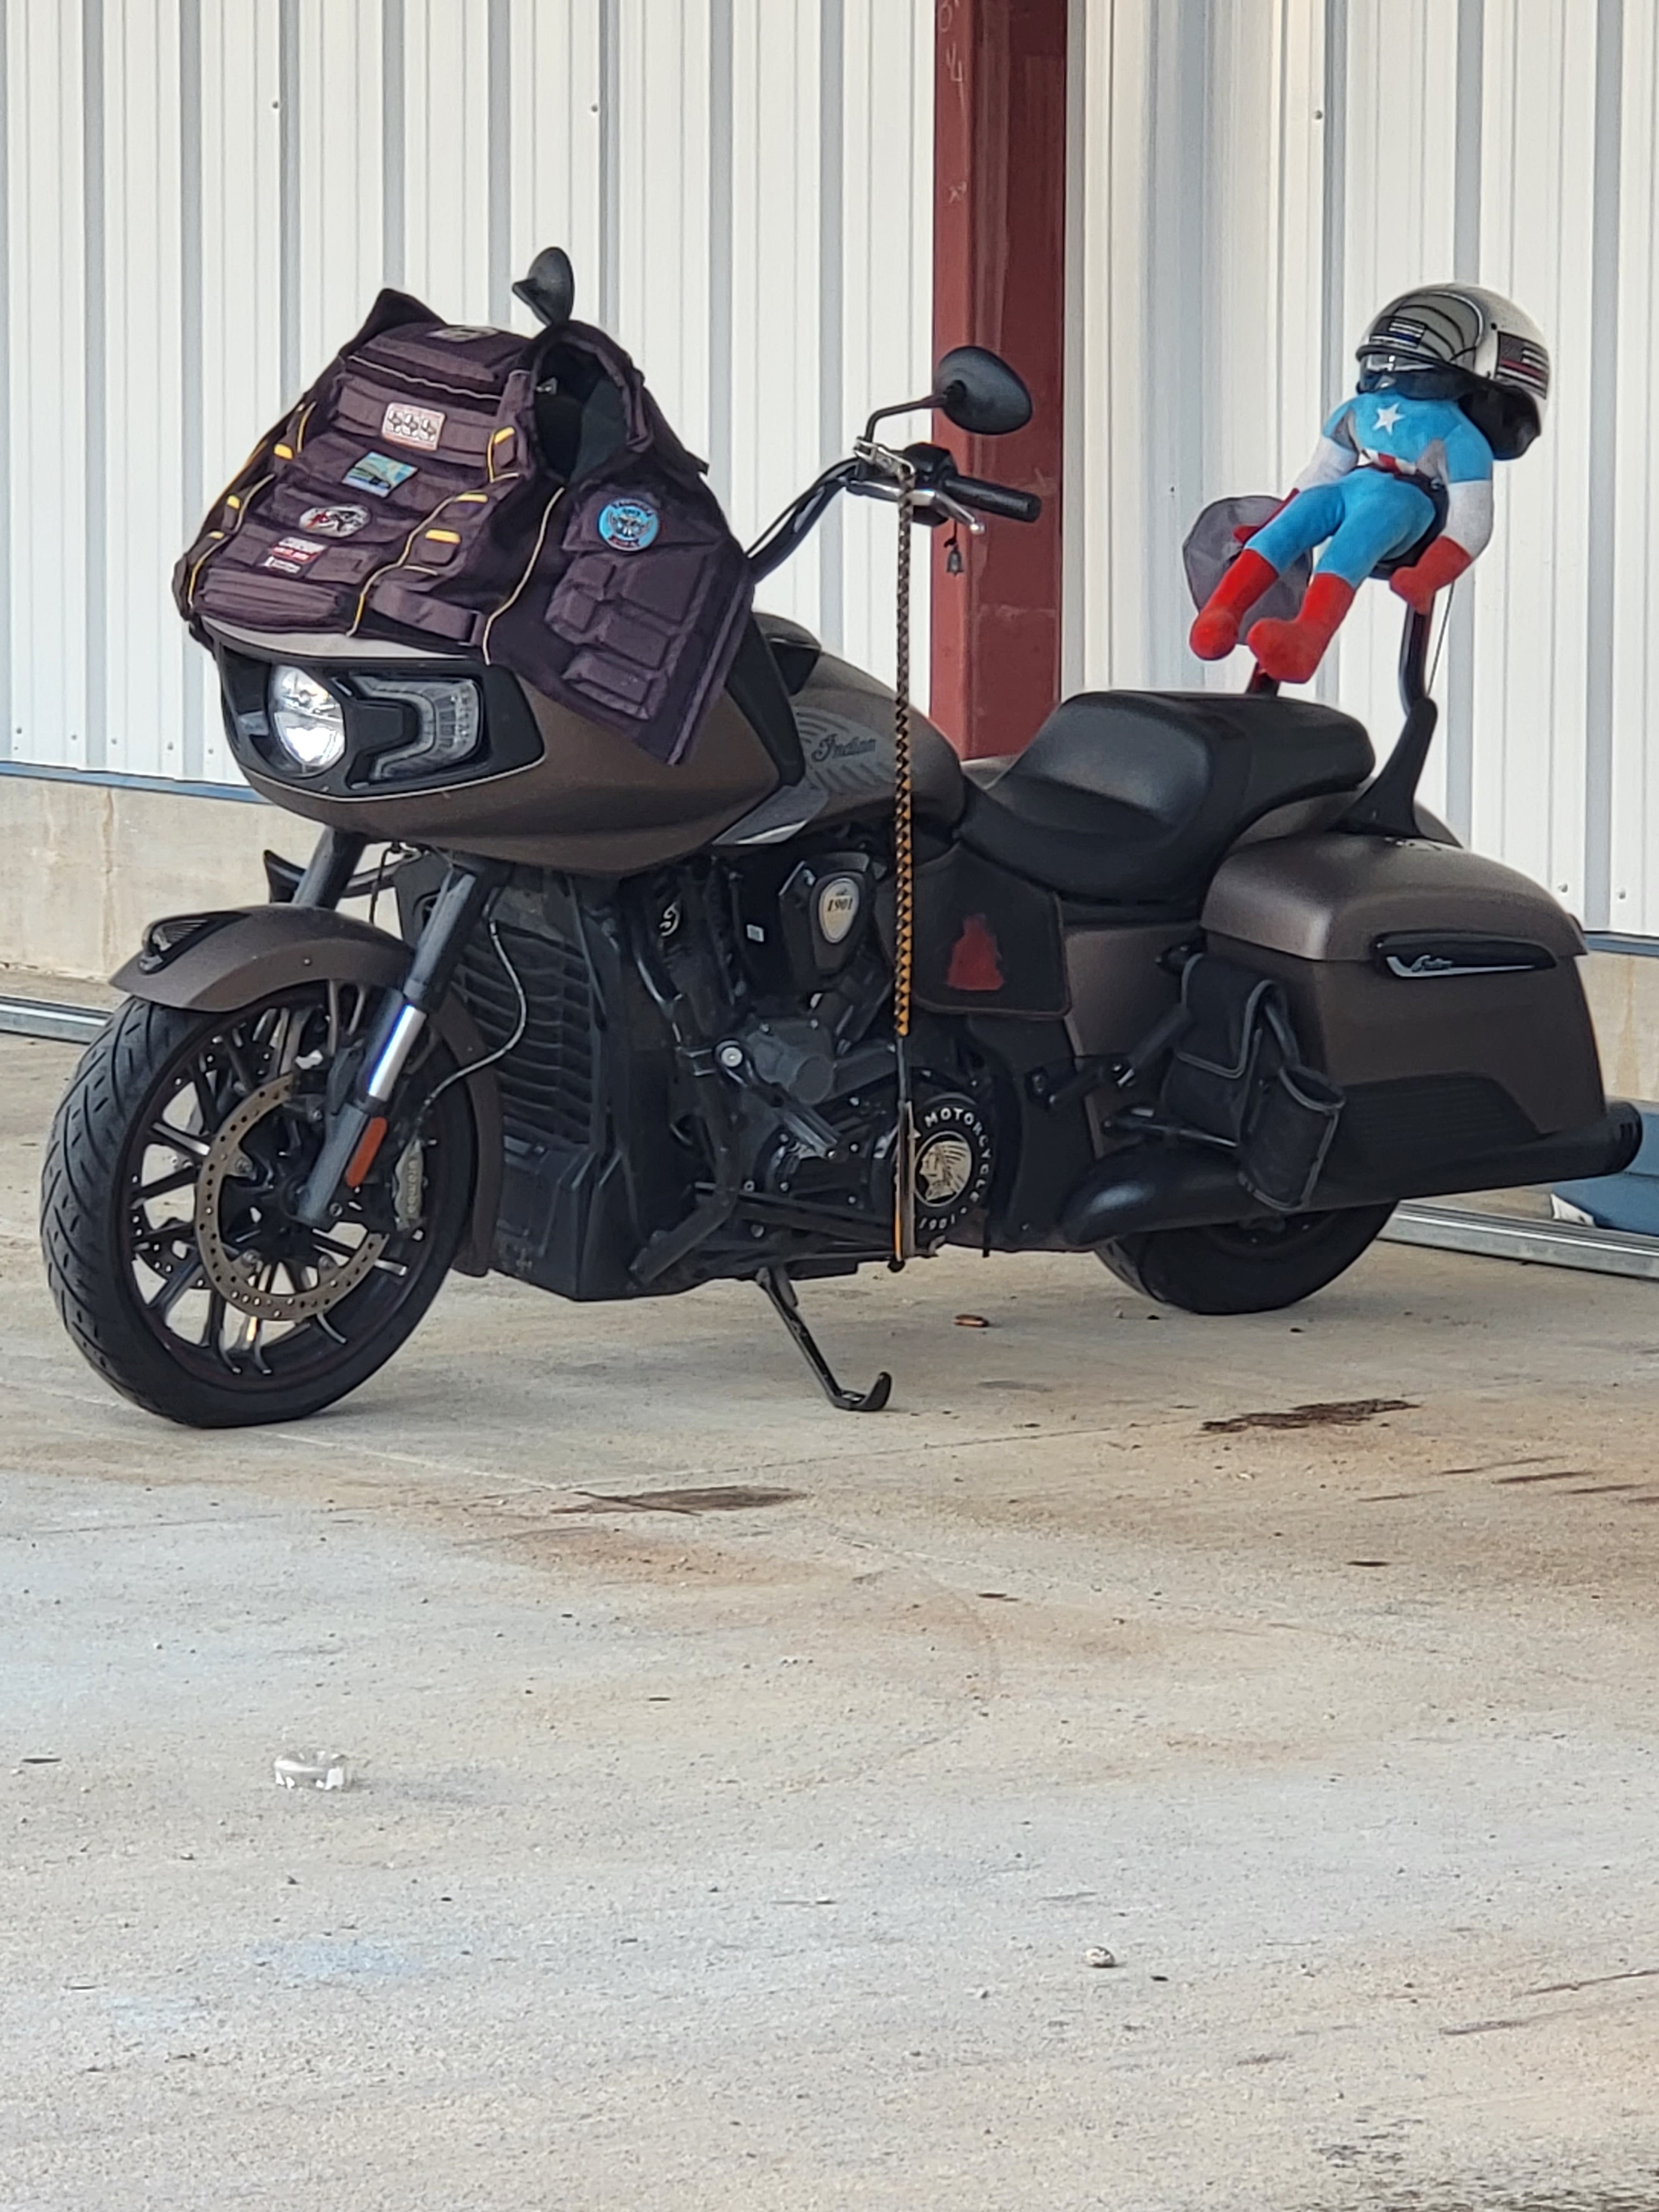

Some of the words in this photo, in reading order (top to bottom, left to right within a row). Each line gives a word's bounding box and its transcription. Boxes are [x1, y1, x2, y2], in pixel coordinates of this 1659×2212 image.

[811, 733, 876, 762] Indian
[828, 898, 853, 912] 1901
[925, 1107, 992, 1202] MOTORCYCLE
[919, 1214, 955, 1230] 1901
